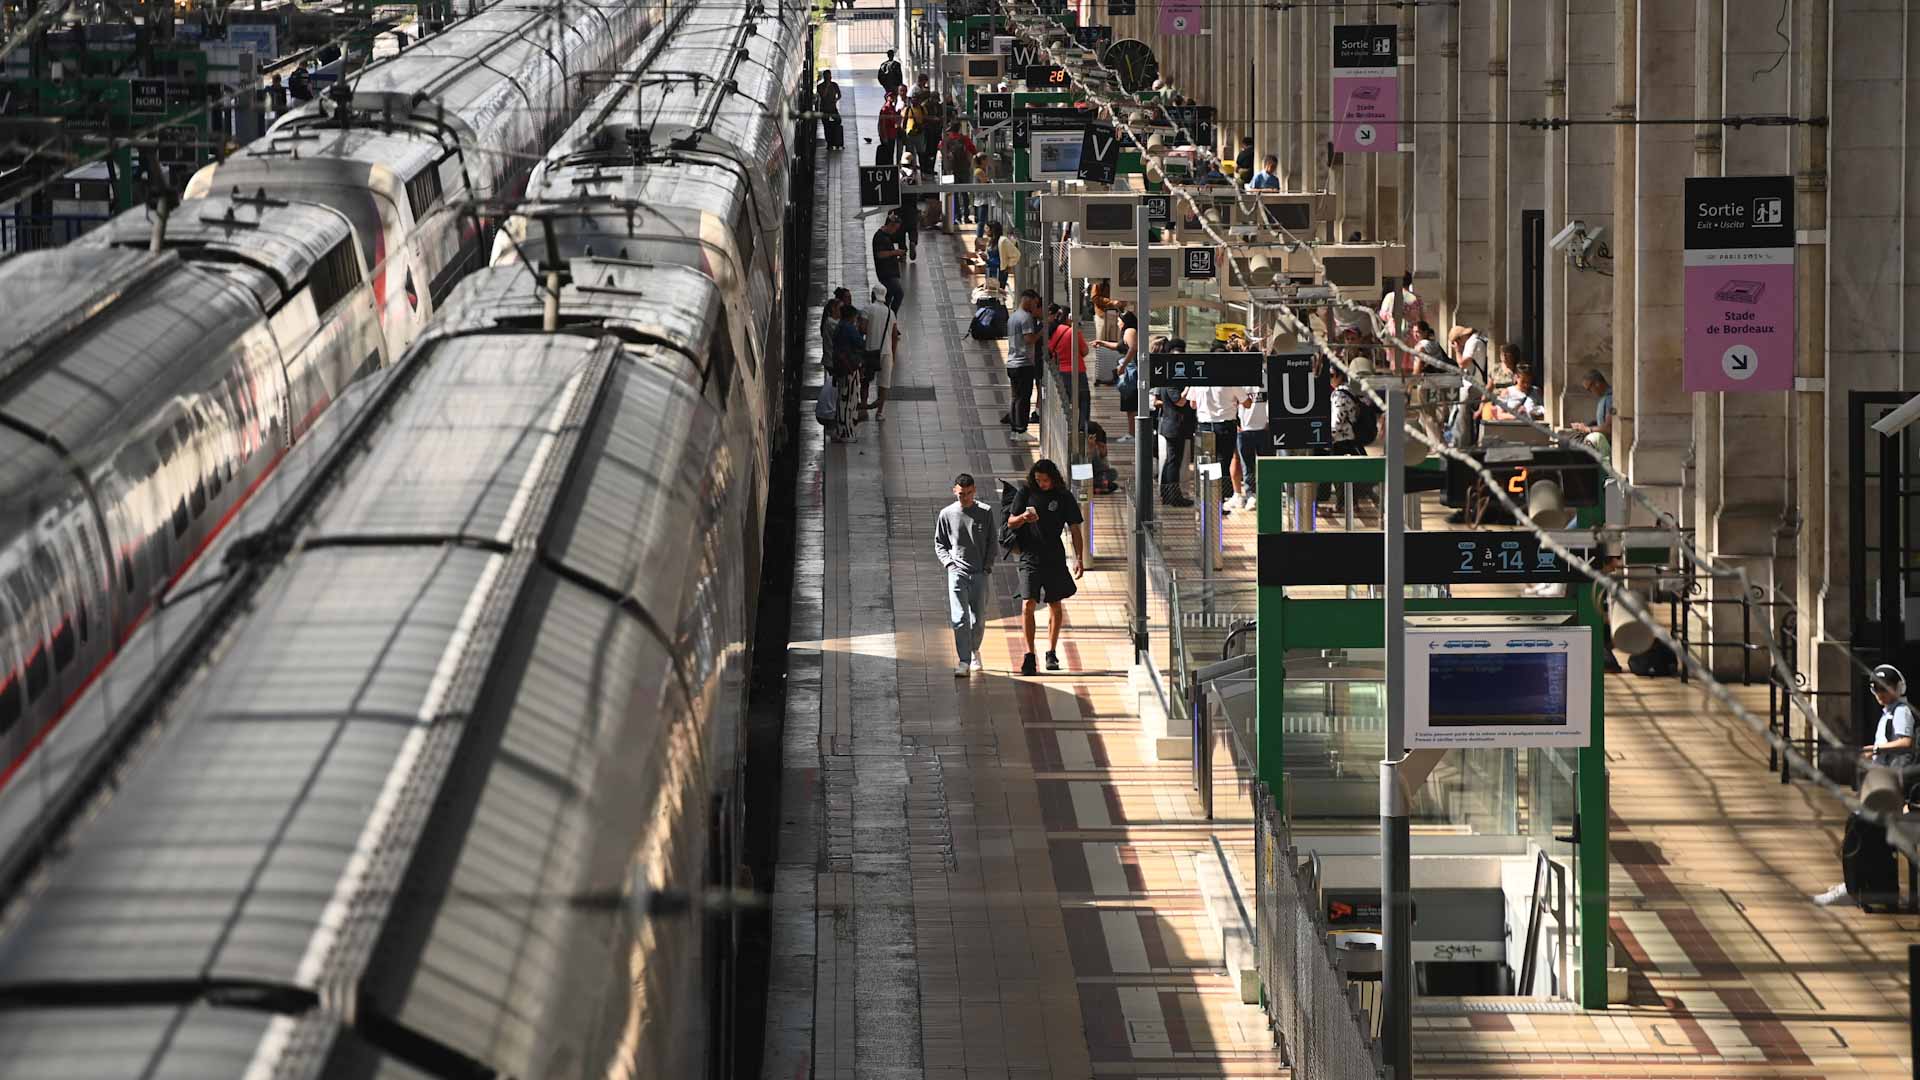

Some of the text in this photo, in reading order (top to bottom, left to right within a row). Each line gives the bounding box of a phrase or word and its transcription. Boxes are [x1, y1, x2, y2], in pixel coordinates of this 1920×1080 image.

[1341, 40, 1369, 49] Sortie
[1013, 46, 1036, 66] W
[1049, 69, 1064, 82] 28
[987, 100, 1004, 108] TER
[982, 111, 1009, 120] NORD
[1092, 134, 1113, 161] V
[867, 170, 892, 182] TGV
[874, 184, 883, 202] 1
[1698, 202, 1745, 217] Sortie
[1696, 221, 1745, 229] Exit Uscita
[1724, 311, 1756, 321] Stade
[1706, 324, 1775, 335] de Bordeaux
[1196, 366, 1204, 377] 1
[1282, 372, 1316, 415] U
[1312, 428, 1323, 443] 1
[1508, 466, 1529, 493] 2
[1460, 548, 1524, 570] 2 à 14
